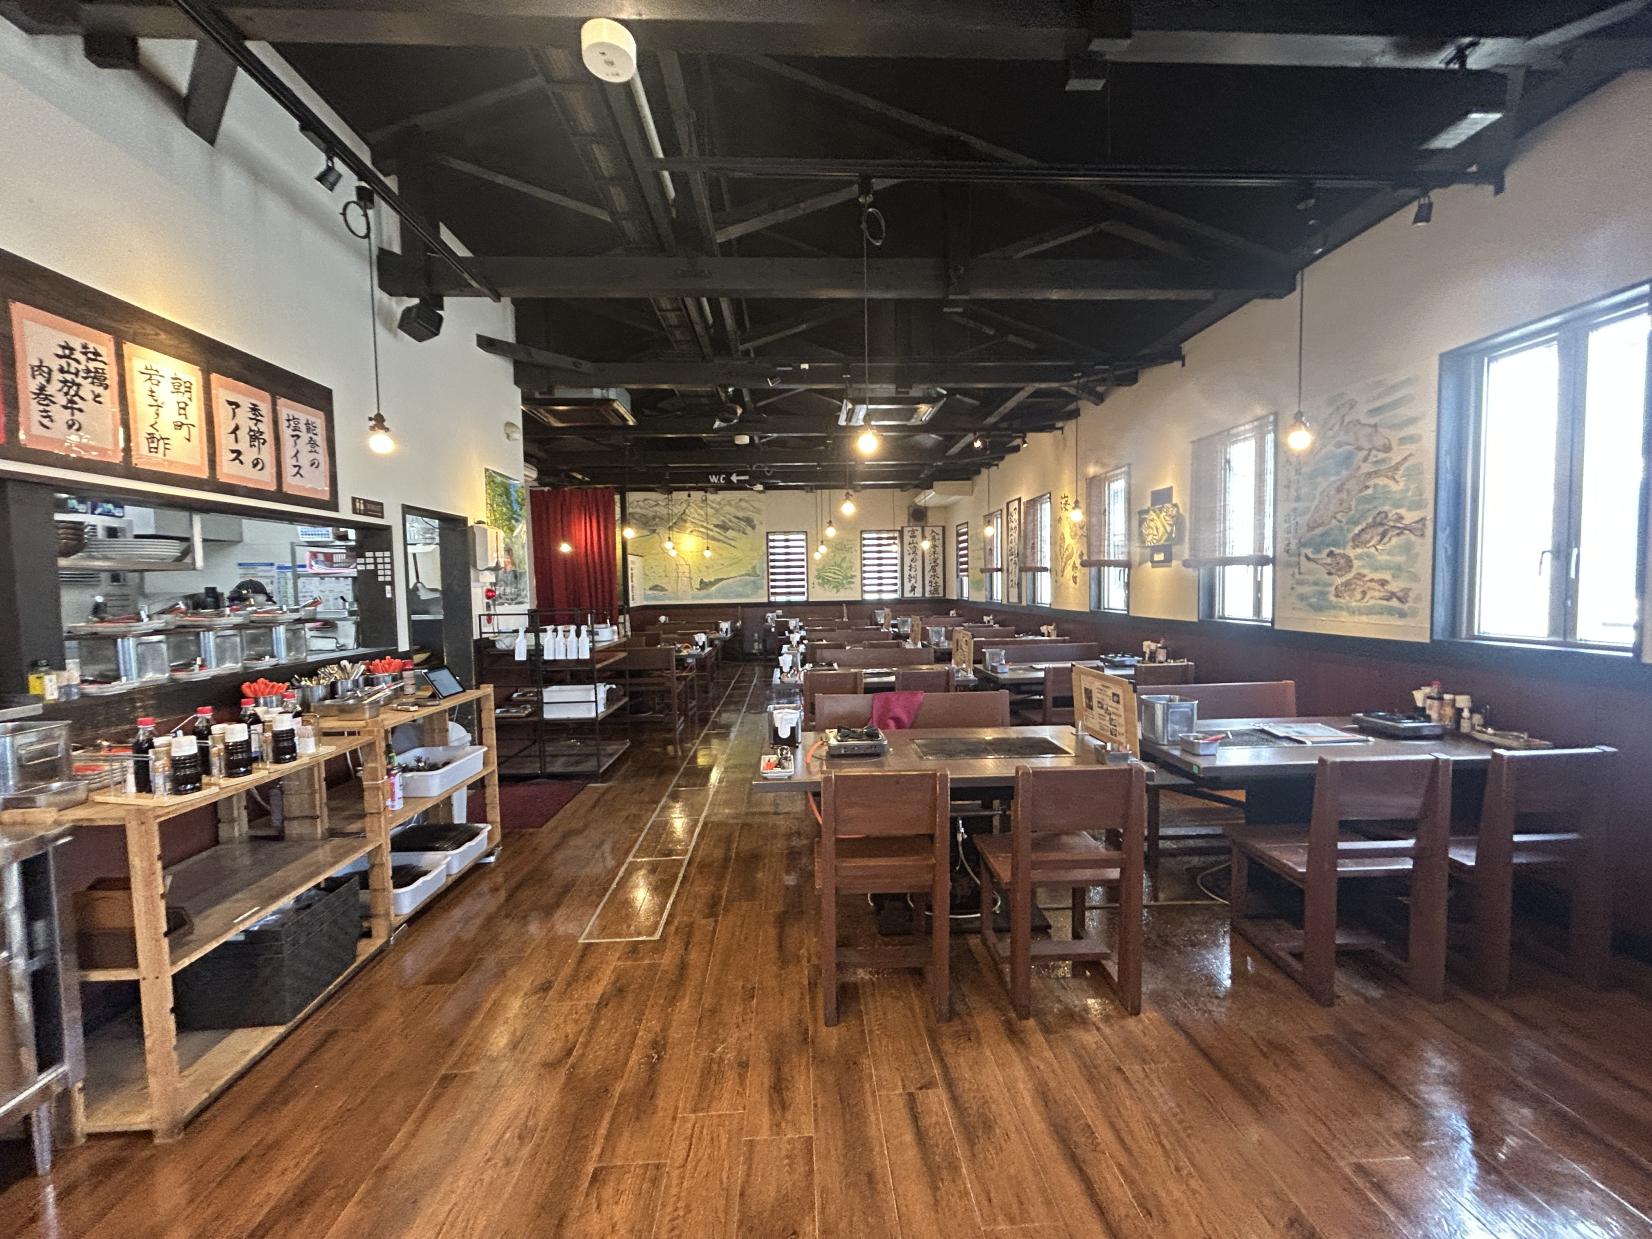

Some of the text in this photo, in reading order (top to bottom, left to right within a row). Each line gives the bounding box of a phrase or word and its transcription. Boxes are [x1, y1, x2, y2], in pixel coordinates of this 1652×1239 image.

[29, 358, 57, 430] 肉巻き
[138, 364, 171, 457] 岩もずく酢
[171, 373, 196, 442] 朝日町
[225, 399, 244, 465] アイス
[248, 402, 267, 471] 季節の
[285, 413, 304, 478] 塩アイス
[304, 418, 320, 469] 能登の
[708, 474, 726, 484] W.C
